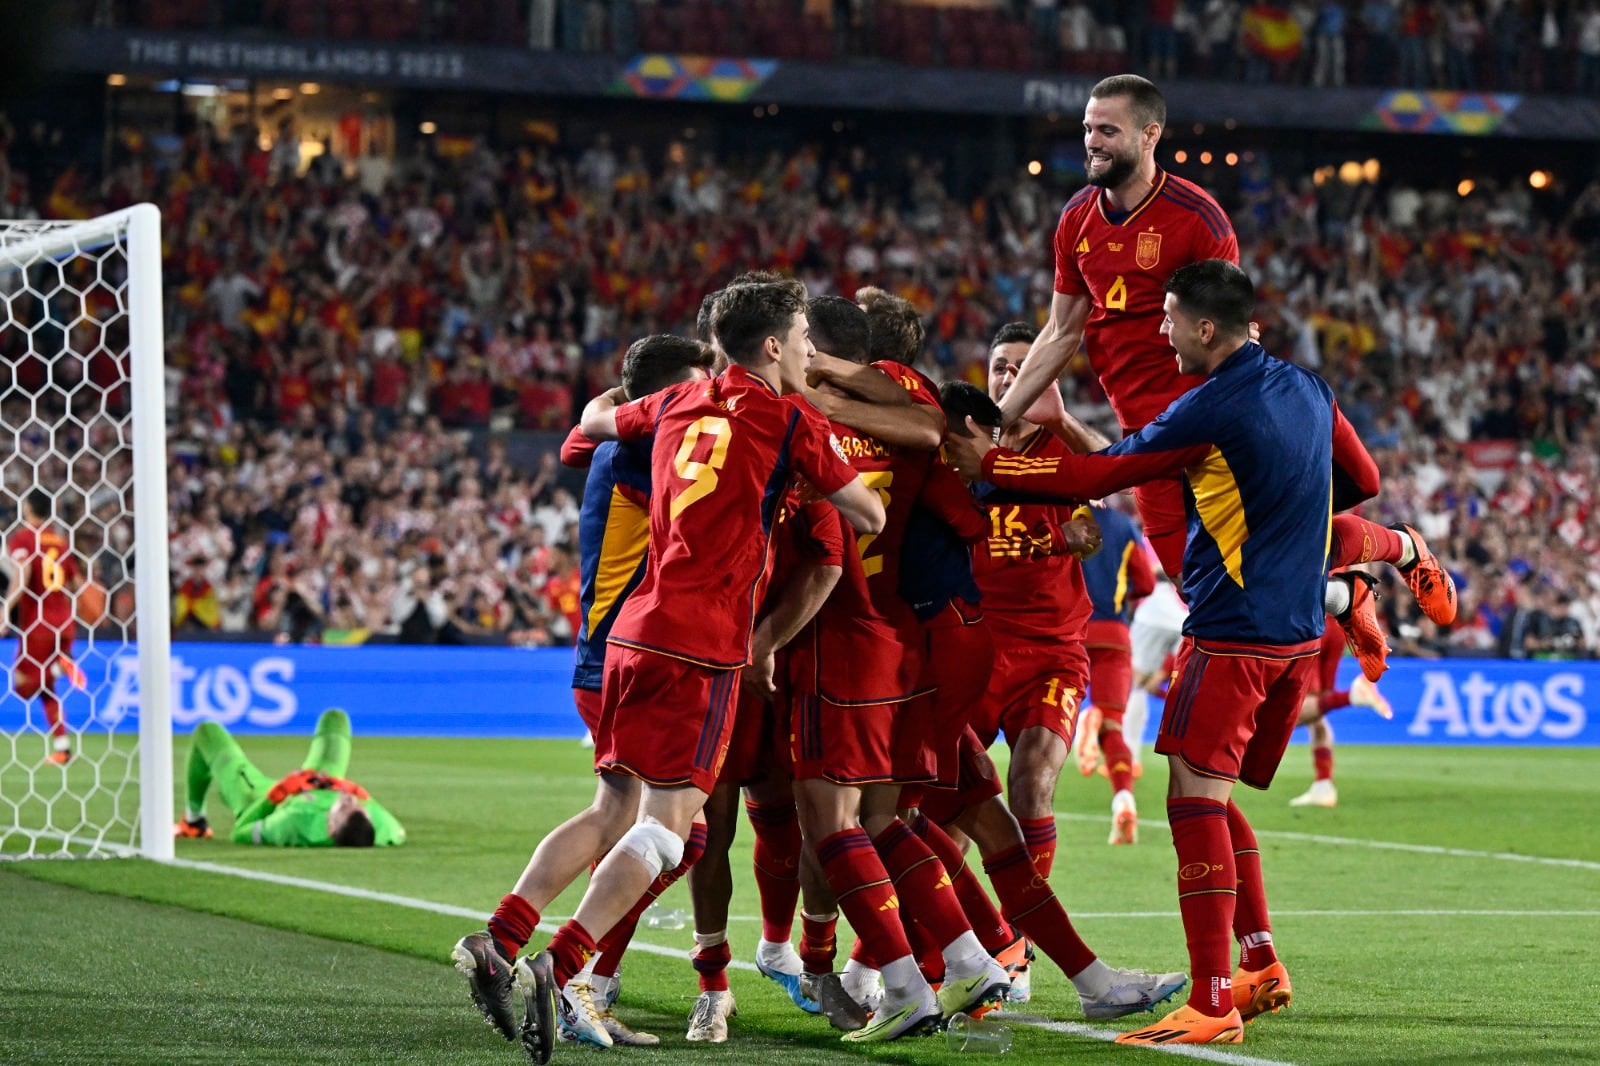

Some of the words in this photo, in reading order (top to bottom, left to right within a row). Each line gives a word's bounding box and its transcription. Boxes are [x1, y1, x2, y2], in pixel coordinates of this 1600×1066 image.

[126, 37, 180, 63] THE
[187, 40, 391, 76] NETHERLANDS
[399, 51, 464, 79] 2023
[1105, 275, 1127, 312] 4
[669, 415, 733, 521] 9
[989, 505, 1028, 538] 16
[42, 547, 66, 592] 6
[1041, 678, 1078, 721] 16
[1211, 976, 1220, 1007] DESIGN
